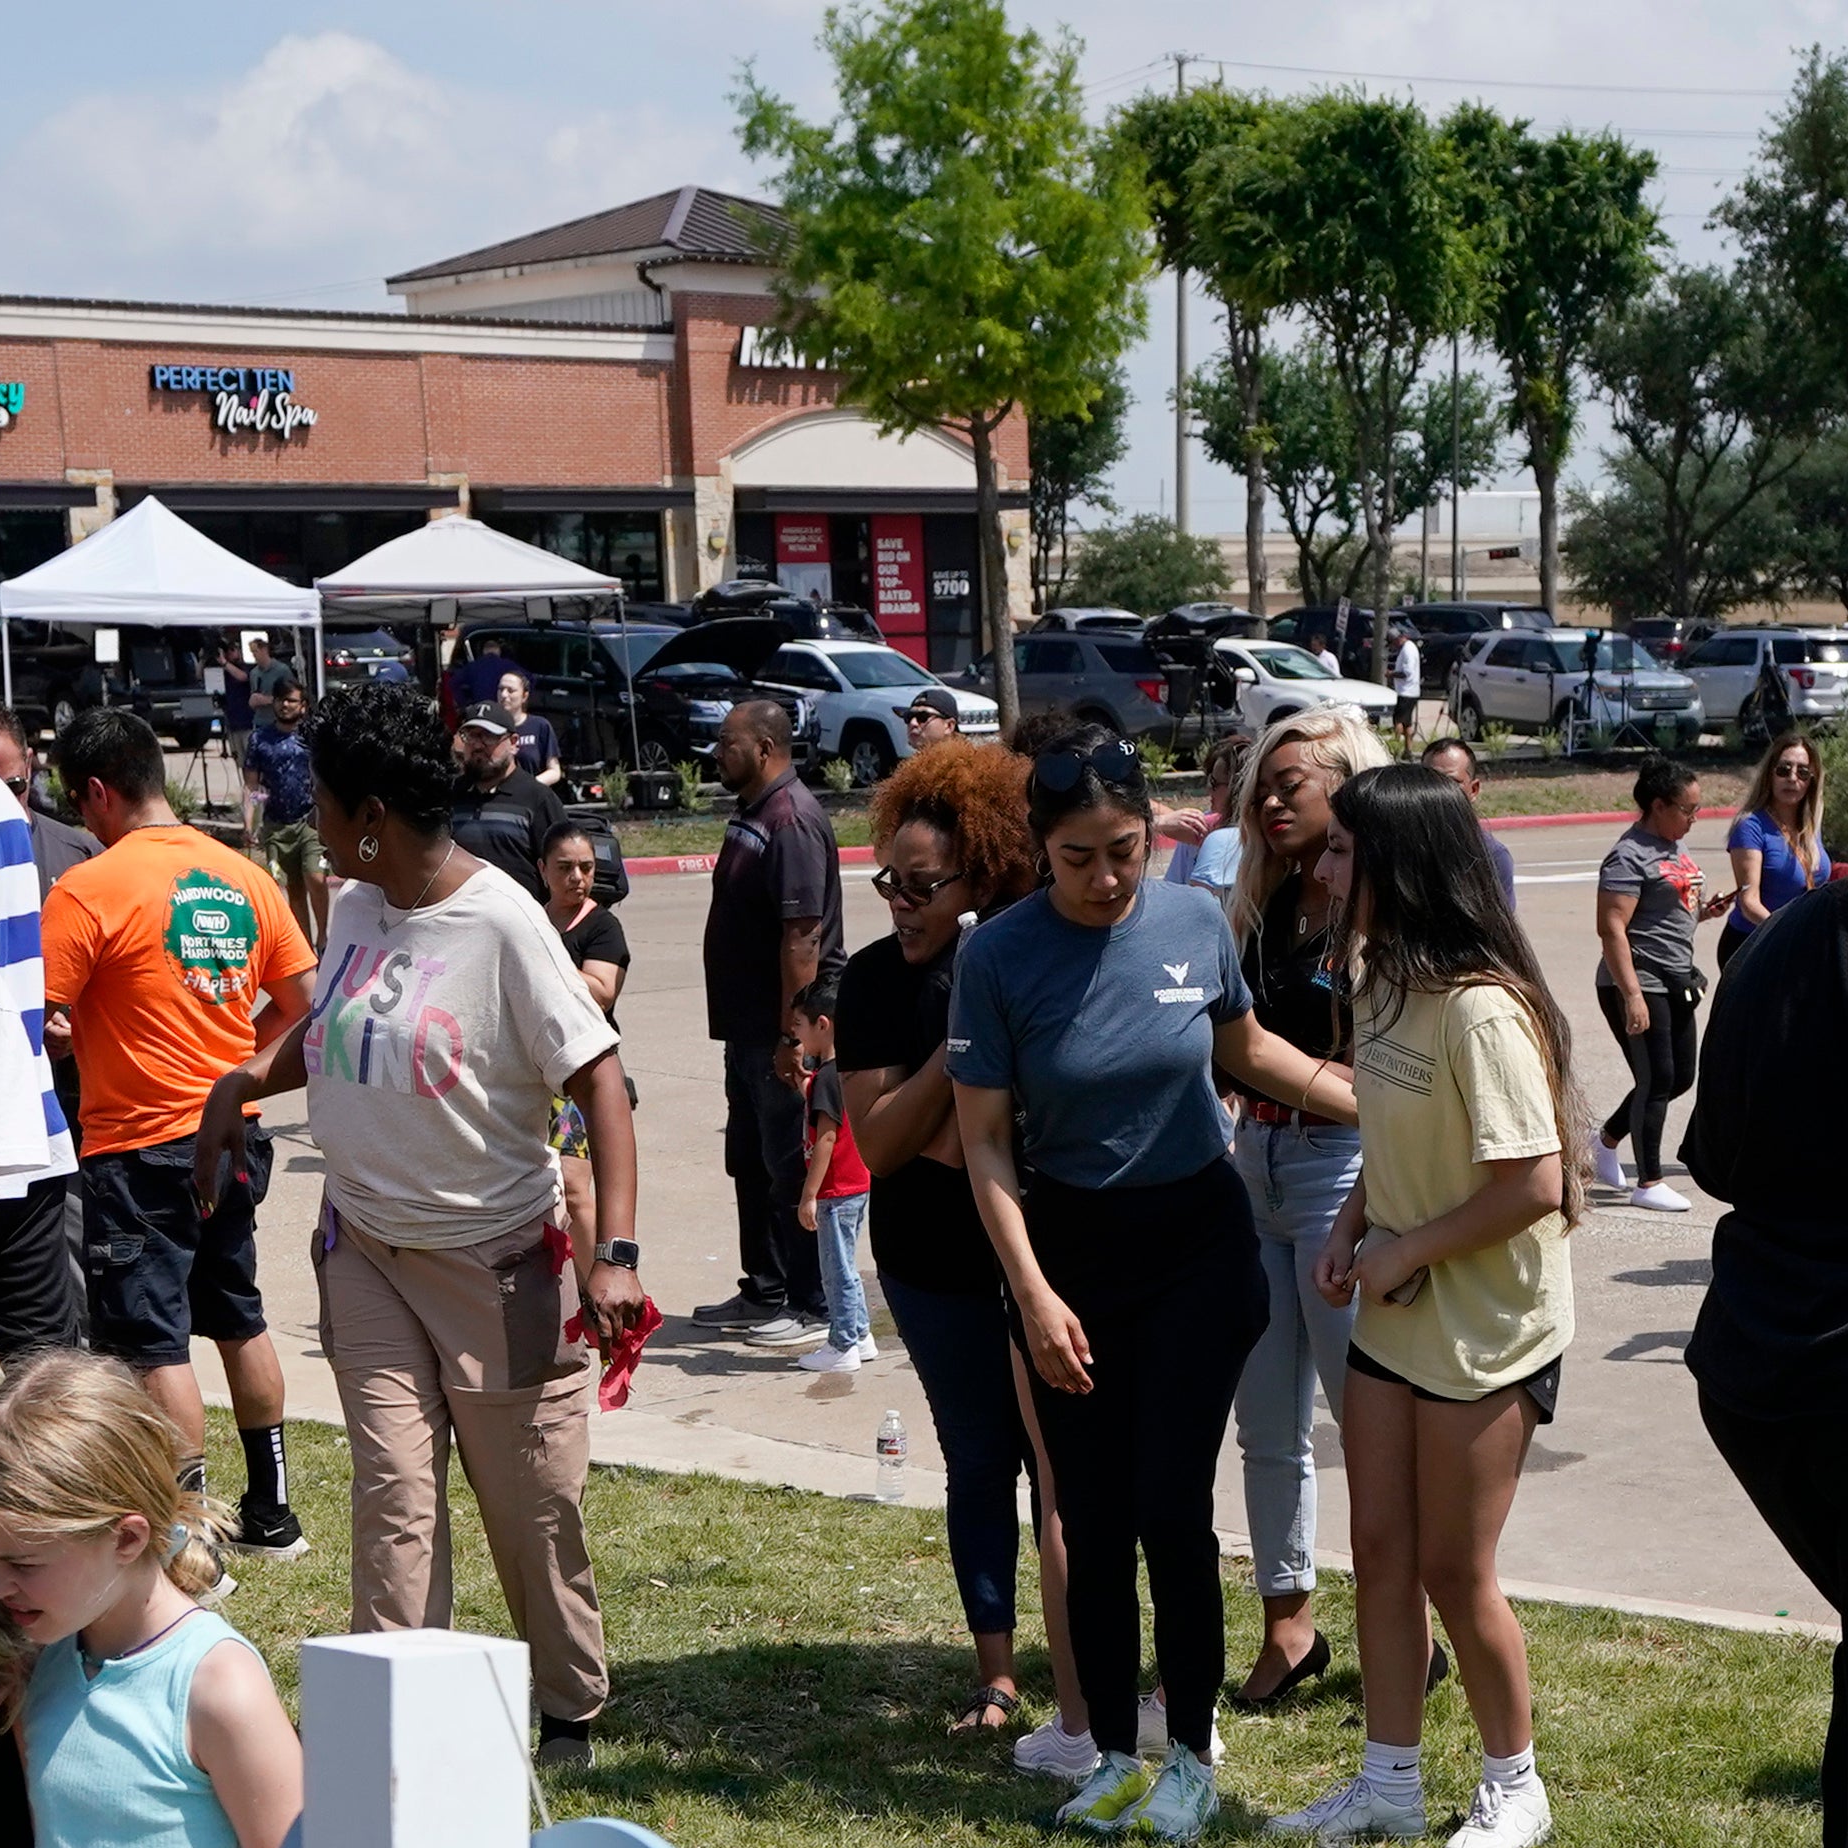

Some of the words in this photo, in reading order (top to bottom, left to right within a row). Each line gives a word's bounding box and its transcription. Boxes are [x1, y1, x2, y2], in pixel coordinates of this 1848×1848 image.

[155, 366, 246, 390] PERFECT
[252, 369, 295, 391] TEN
[216, 389, 270, 433] Nail
[271, 392, 318, 439] Spa
[877, 537, 904, 549] SAVE
[877, 551, 895, 562] BIG
[896, 551, 911, 562] ON
[878, 564, 899, 576] OUR
[878, 577, 903, 588] TOP-
[933, 580, 970, 596] $700
[879, 590, 912, 601] RATED
[879, 603, 920, 614] BRANDS
[477, 703, 491, 718] T
[677, 858, 705, 872] FIRE
[173, 887, 245, 906] HARDWOOD
[310, 944, 446, 1023] JUST
[325, 998, 463, 1100] KIND
[1386, 1055, 1433, 1085] PANTHERS
